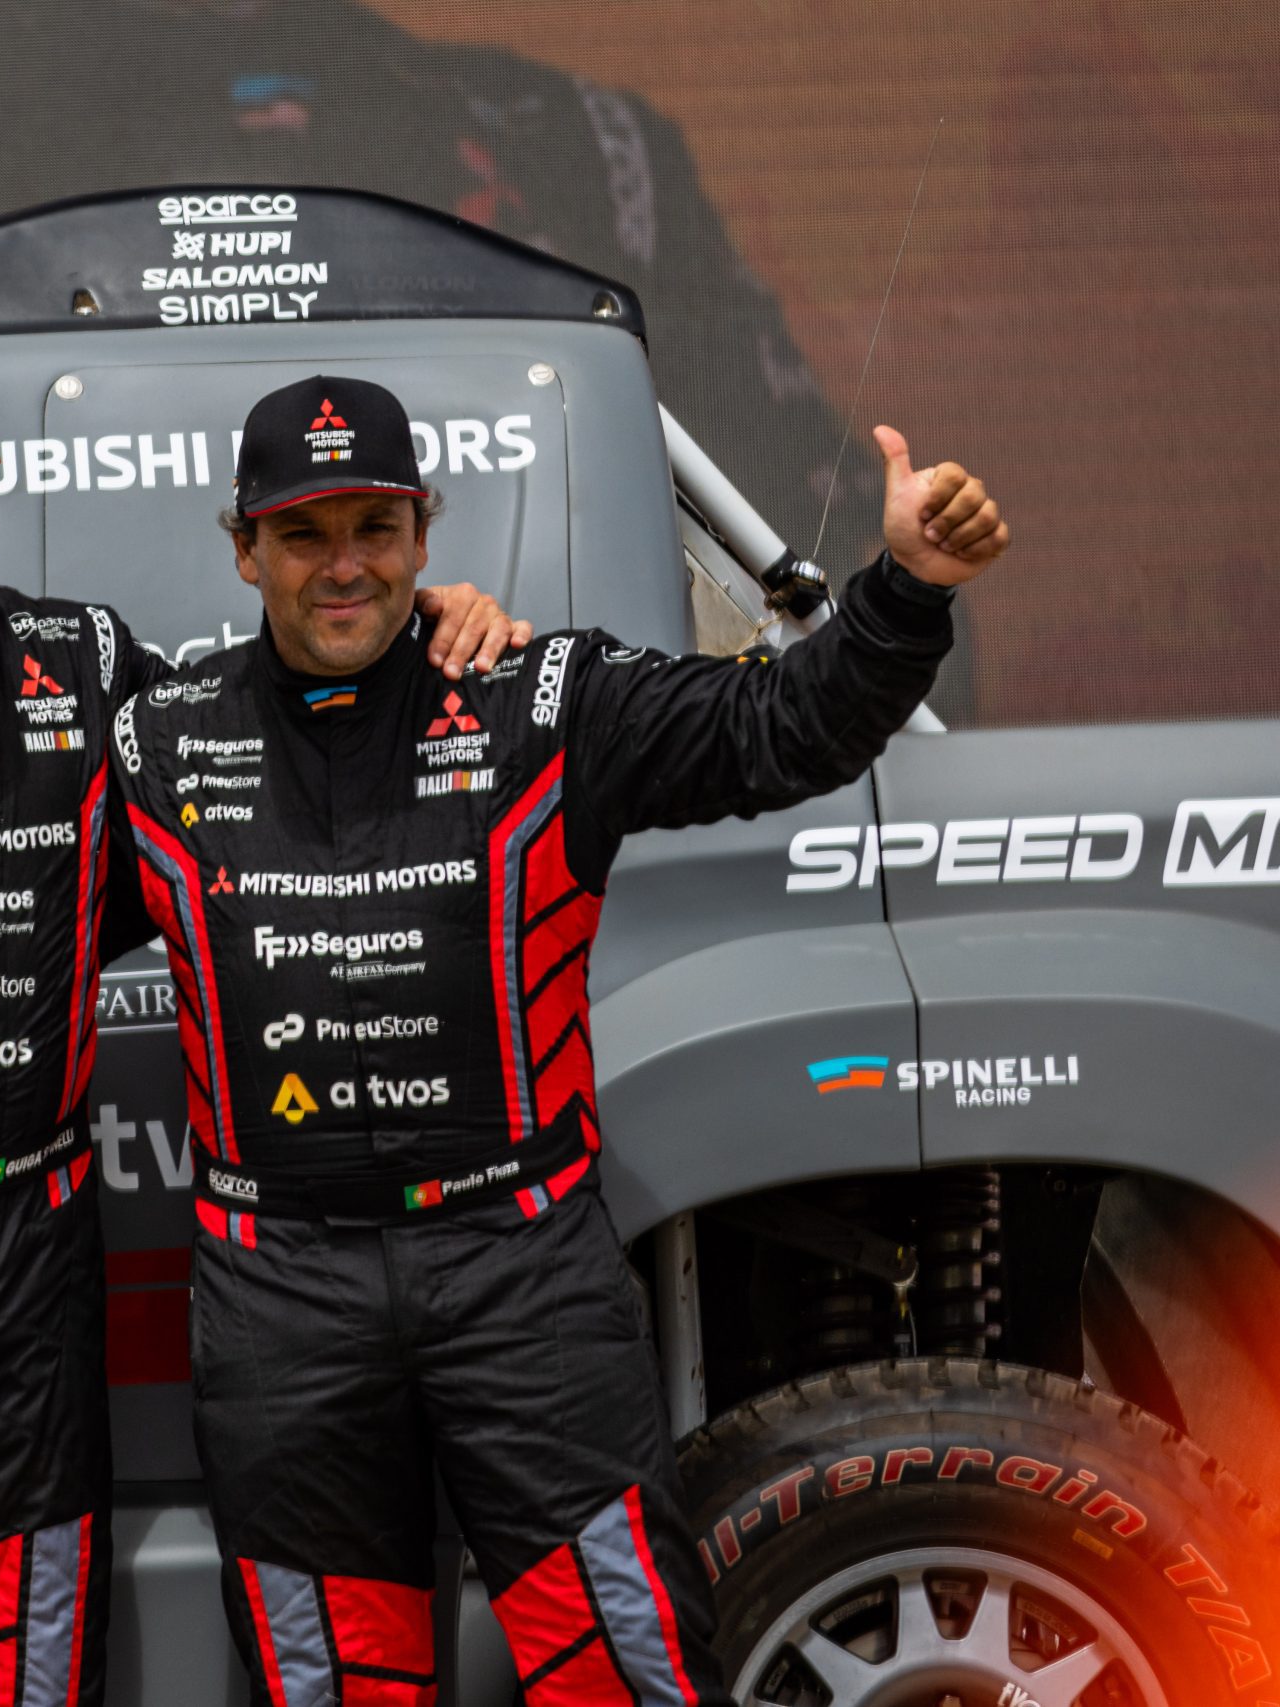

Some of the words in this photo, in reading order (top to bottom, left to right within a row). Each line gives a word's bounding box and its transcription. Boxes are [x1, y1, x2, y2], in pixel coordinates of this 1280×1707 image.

[158, 194, 298, 225] sparco
[210, 230, 292, 256] HUPI
[141, 262, 328, 290] SALOMON
[159, 291, 318, 325] SIMPLY
[304, 430, 355, 442] MITSUBISHI
[312, 438, 349, 448] MOTORS
[531, 637, 576, 729] sparco
[416, 732, 490, 756] MITSUBISHI
[427, 748, 483, 767] MOTORS
[202, 775, 261, 790] PneuStore
[204, 803, 253, 821] atvos
[786, 811, 1145, 893] SPEED
[239, 872, 370, 898] MITSUBISHI
[376, 859, 477, 893] MOTORS
[310, 929, 424, 960] Seguros
[315, 1015, 439, 1042] PneuStore
[896, 1054, 1079, 1092] SPINELLI
[330, 1074, 451, 1108] atvos
[954, 1087, 1032, 1109] RACING
[5, 1150, 42, 1178] GUIGA
[442, 1174, 484, 1197] Paulo
